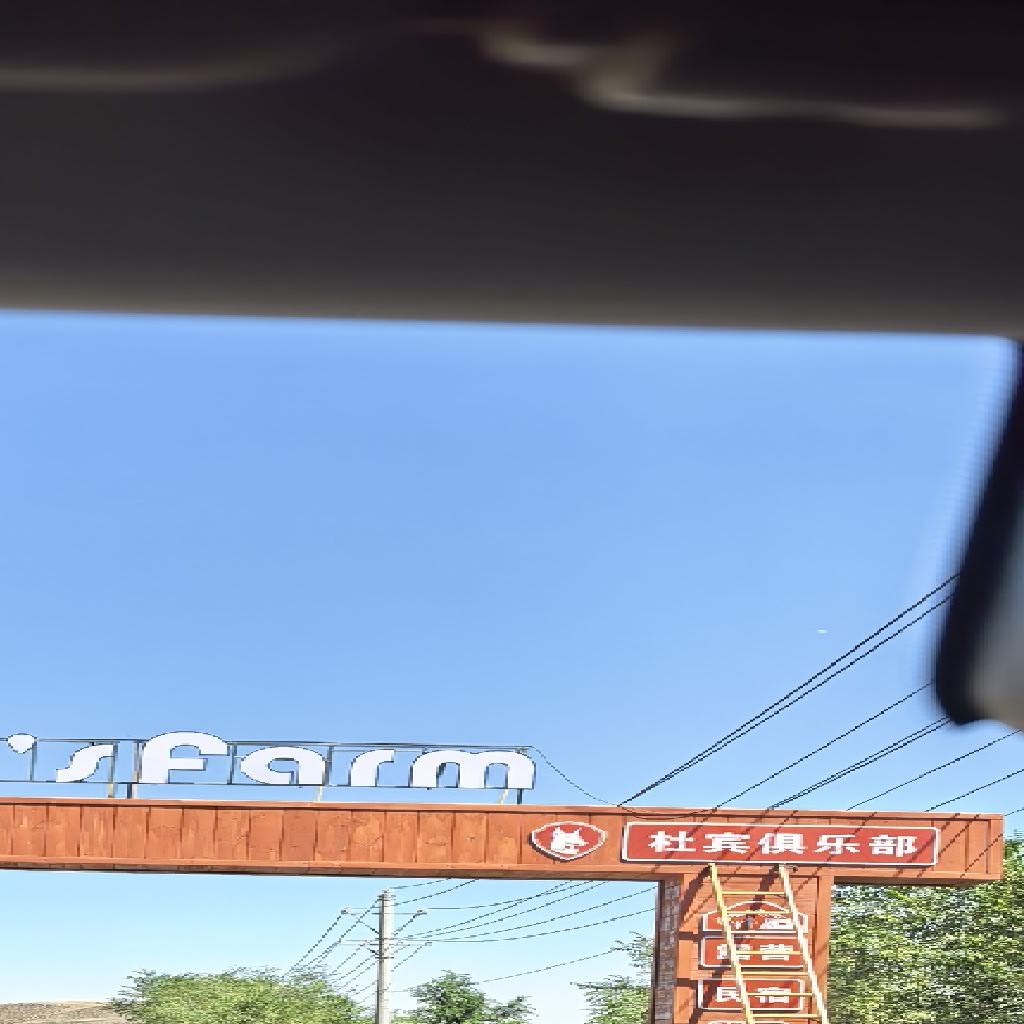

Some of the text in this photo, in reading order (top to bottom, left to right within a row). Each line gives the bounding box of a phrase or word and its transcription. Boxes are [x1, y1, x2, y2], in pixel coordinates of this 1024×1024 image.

[648, 831, 917, 857] 杜宾俱乐部
